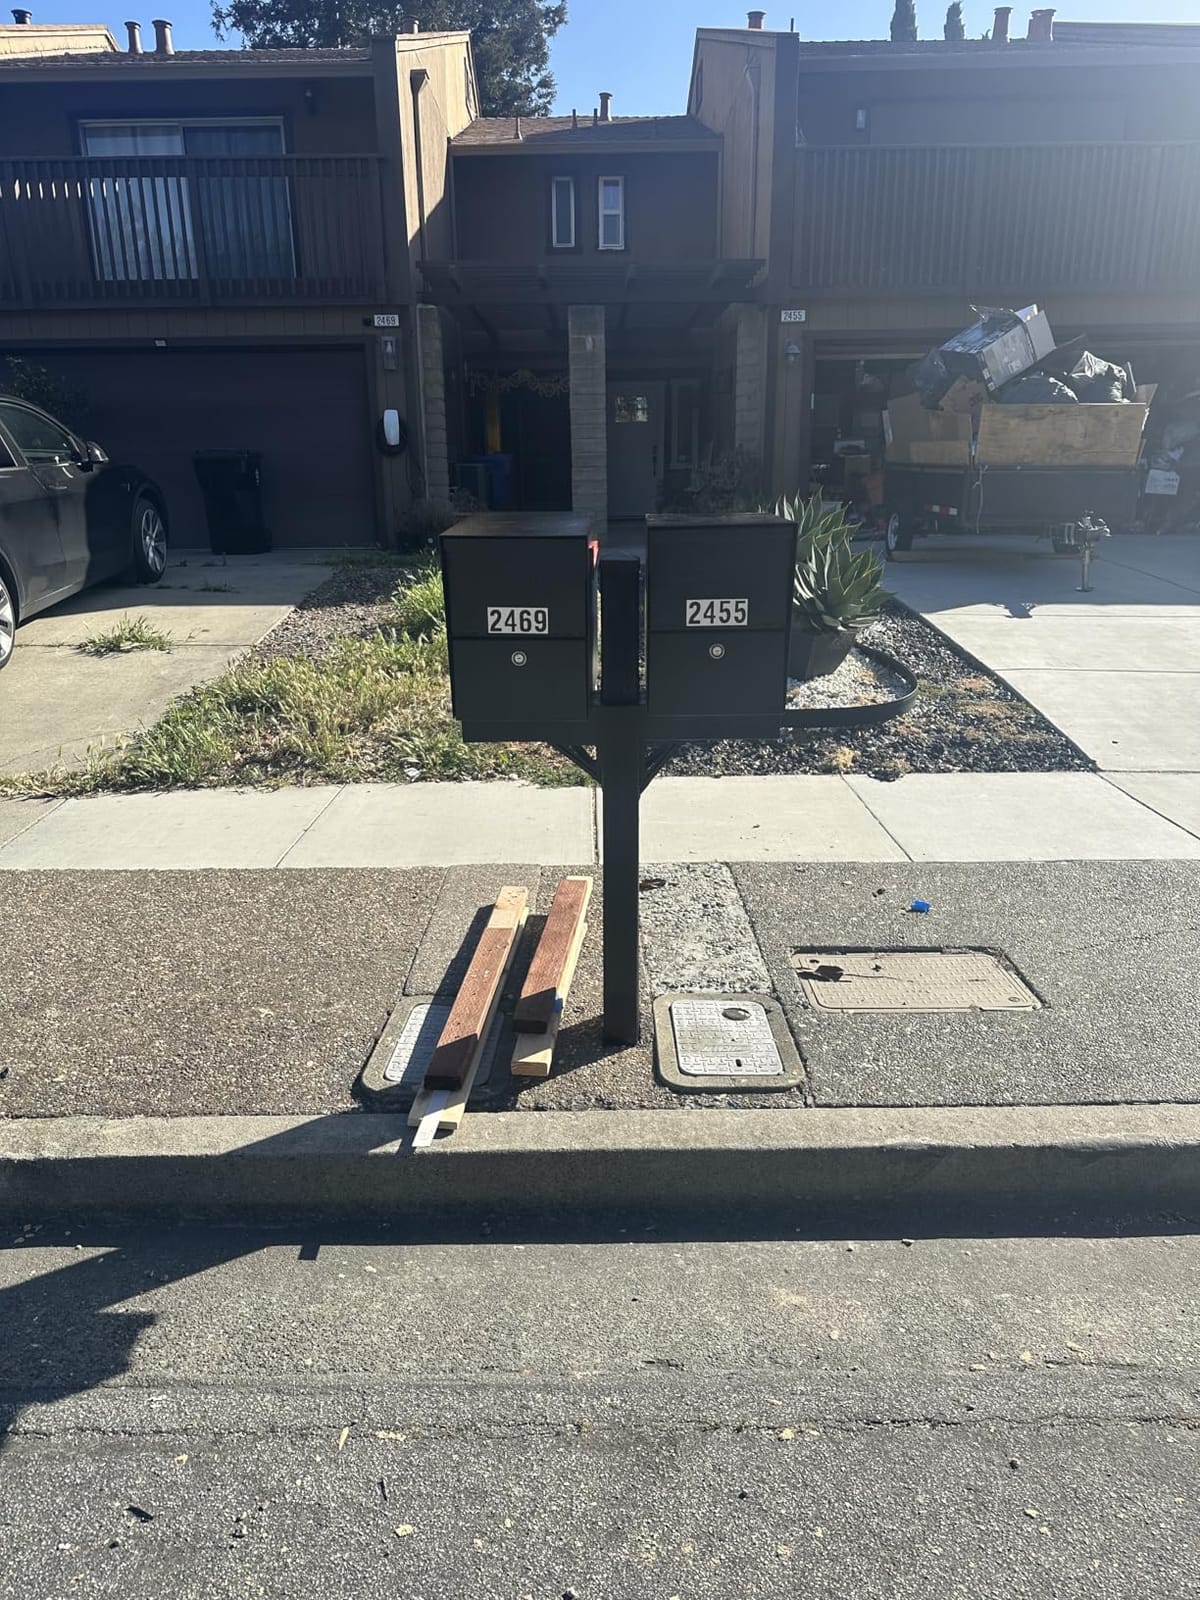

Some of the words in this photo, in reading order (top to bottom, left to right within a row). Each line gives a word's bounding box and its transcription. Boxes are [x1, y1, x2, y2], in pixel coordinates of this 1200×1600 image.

[376, 316, 396, 325] 2469
[783, 311, 803, 321] 2455
[688, 600, 746, 624] 2455
[489, 609, 547, 632] 2469
